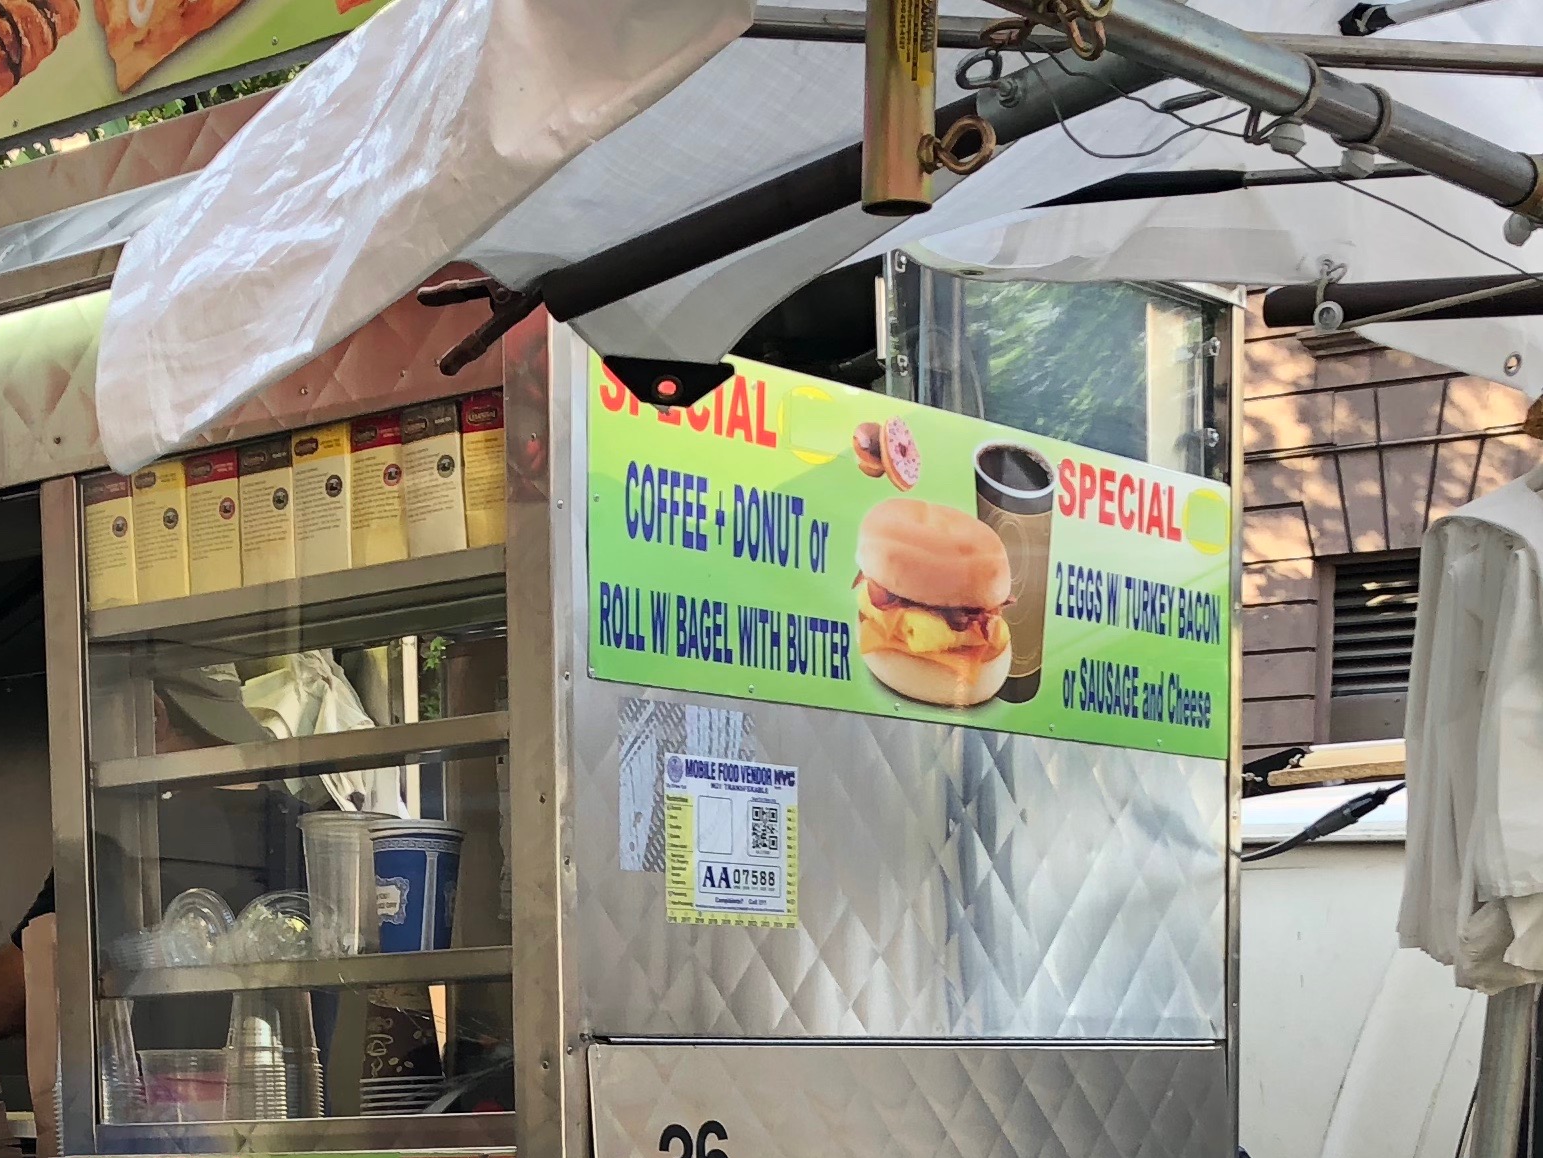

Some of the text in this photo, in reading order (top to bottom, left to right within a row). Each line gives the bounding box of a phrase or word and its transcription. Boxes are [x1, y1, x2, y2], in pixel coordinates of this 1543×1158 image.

[600, 359, 777, 448] SIAL
[625, 461, 828, 573] COFFEE + DONUT or
[1058, 459, 1182, 542] SPECIAL
[600, 582, 851, 681] ROLL W/ BAGEL WITH BUTTER
[1055, 561, 1220, 645] 2 EGGS W/ TURKEY BACON
[1063, 657, 1211, 728] or SAUSAGE and Cheese
[685, 759, 795, 786] MOBILE FOOD VENDOR NYC
[702, 866, 775, 888] AA 07588
